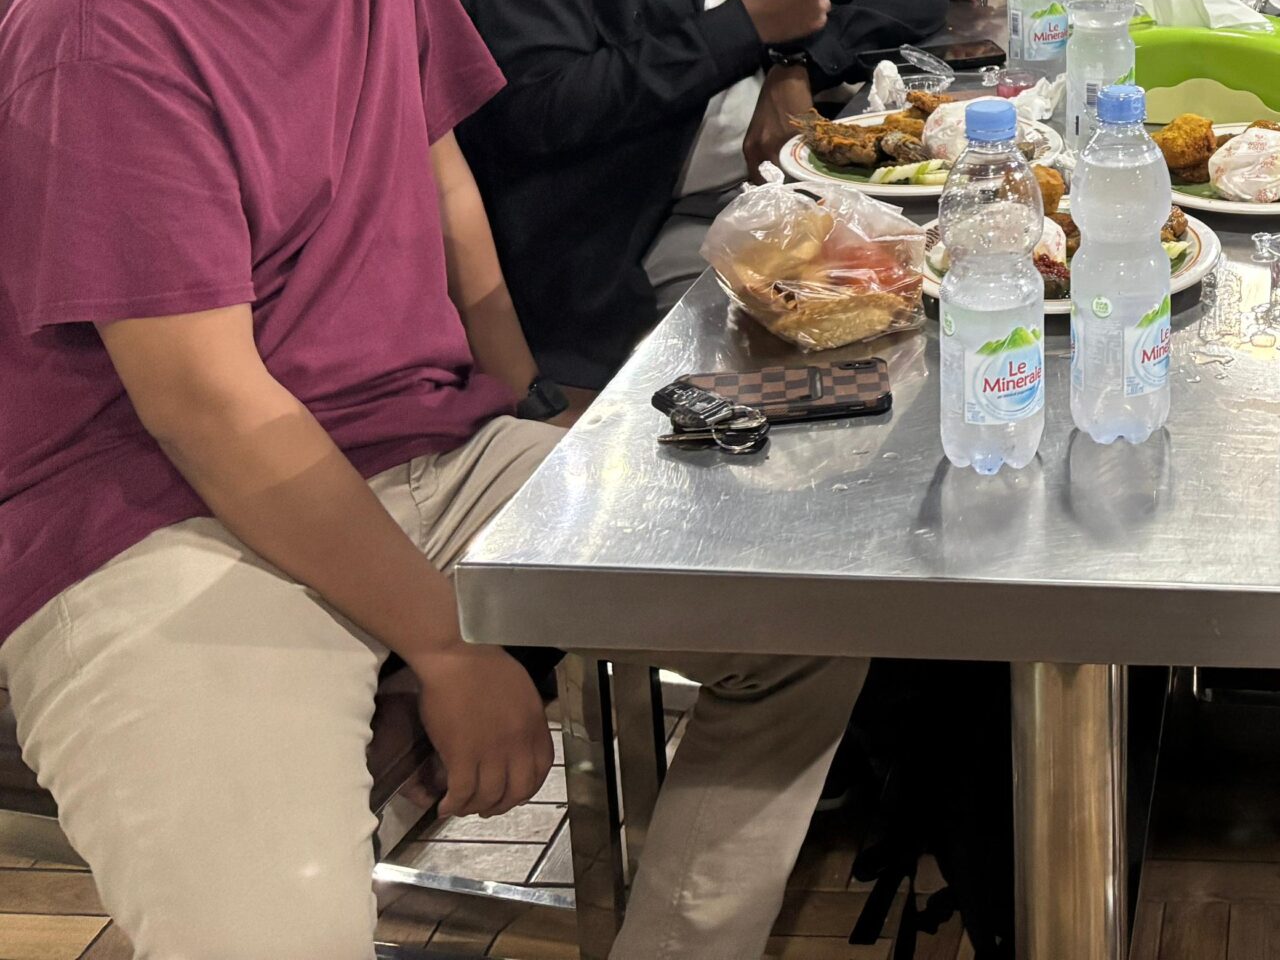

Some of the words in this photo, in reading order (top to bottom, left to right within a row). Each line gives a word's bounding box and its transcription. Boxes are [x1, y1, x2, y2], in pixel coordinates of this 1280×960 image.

[1048, 22, 1059, 32] Le
[1009, 361, 1027, 377] Le
[983, 367, 1042, 393] Minerale
